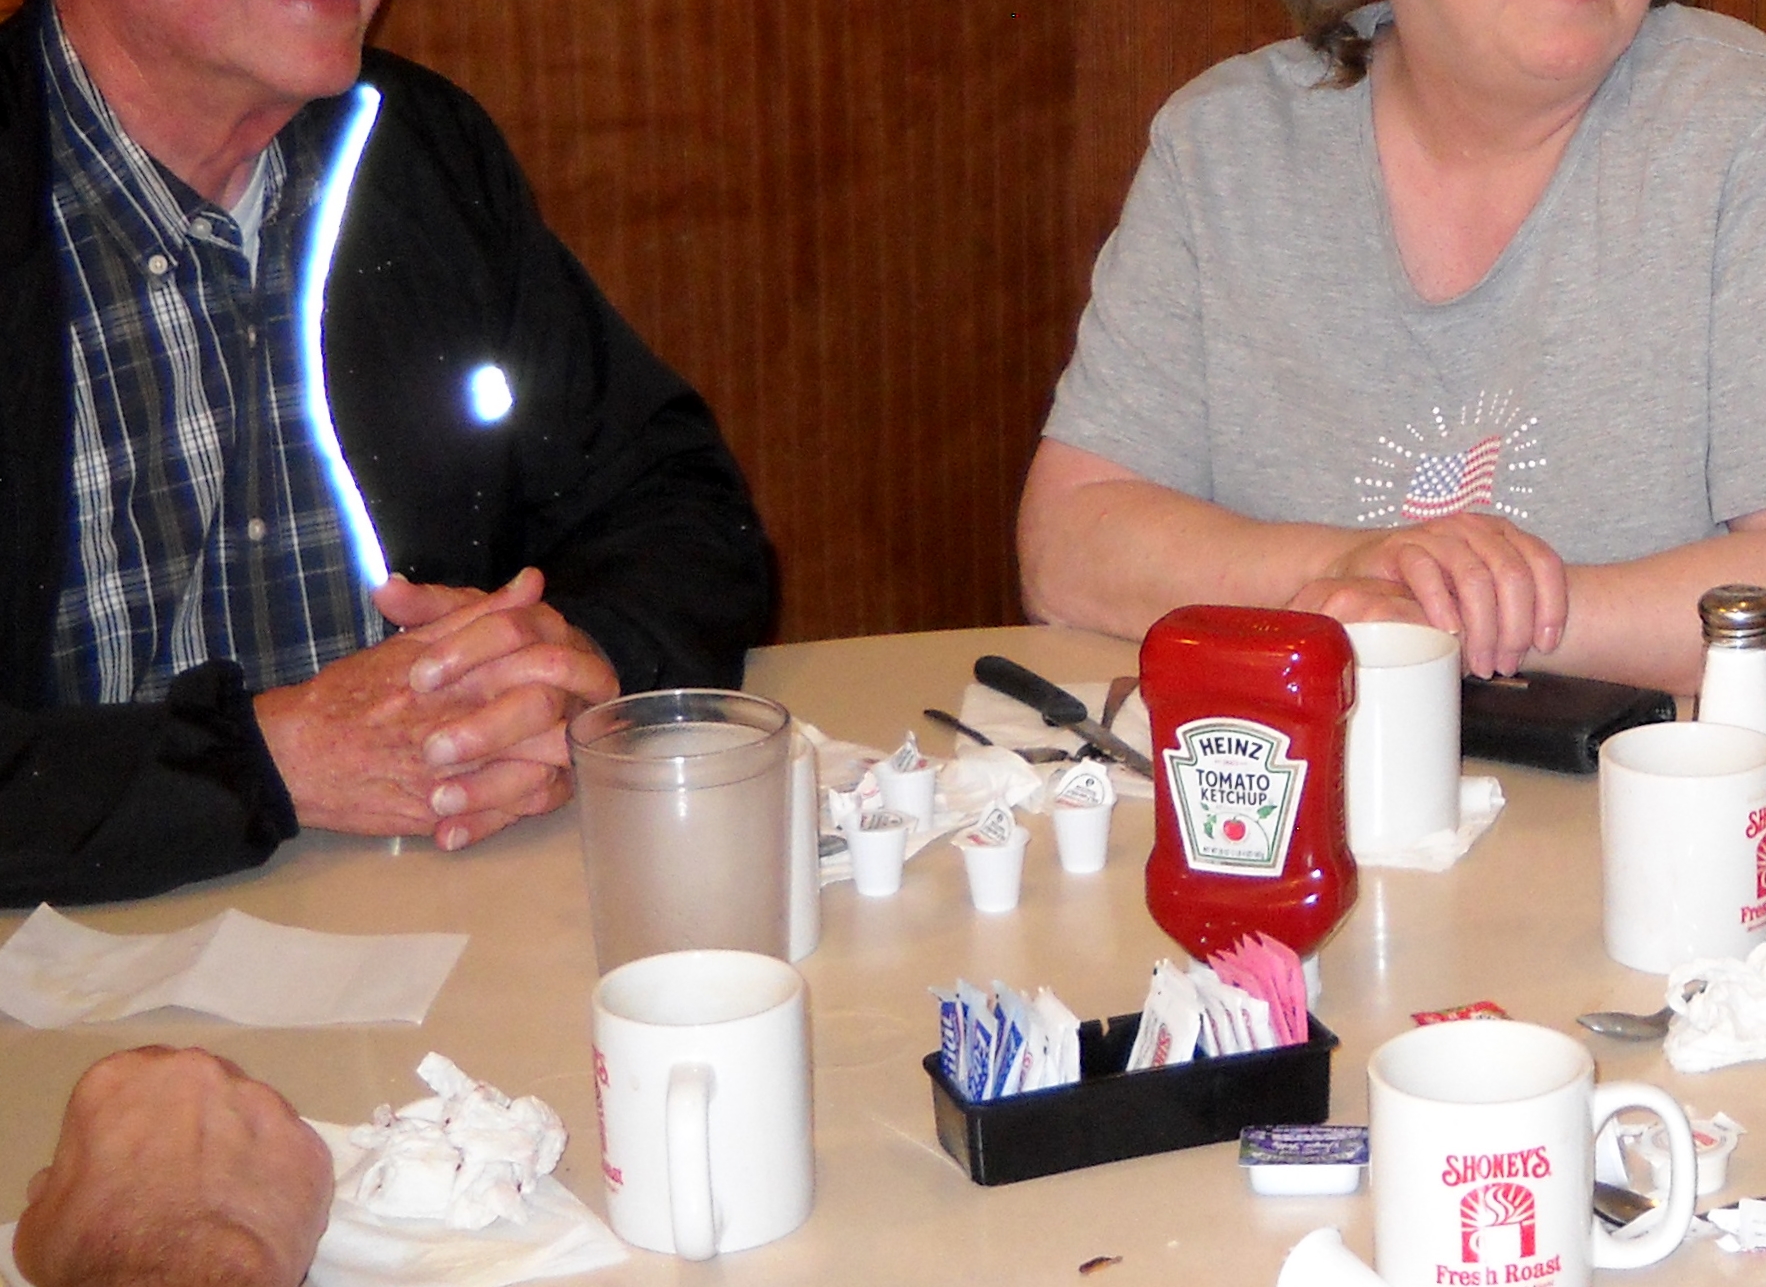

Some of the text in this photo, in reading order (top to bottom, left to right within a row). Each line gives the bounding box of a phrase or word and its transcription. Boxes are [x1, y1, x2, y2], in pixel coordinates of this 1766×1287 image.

[1199, 736, 1264, 761] HEINZ
[1196, 768, 1271, 791] TOMATO
[1200, 787, 1268, 806] KETCHUP
[1436, 1253, 1562, 1286] Fresh Roast
